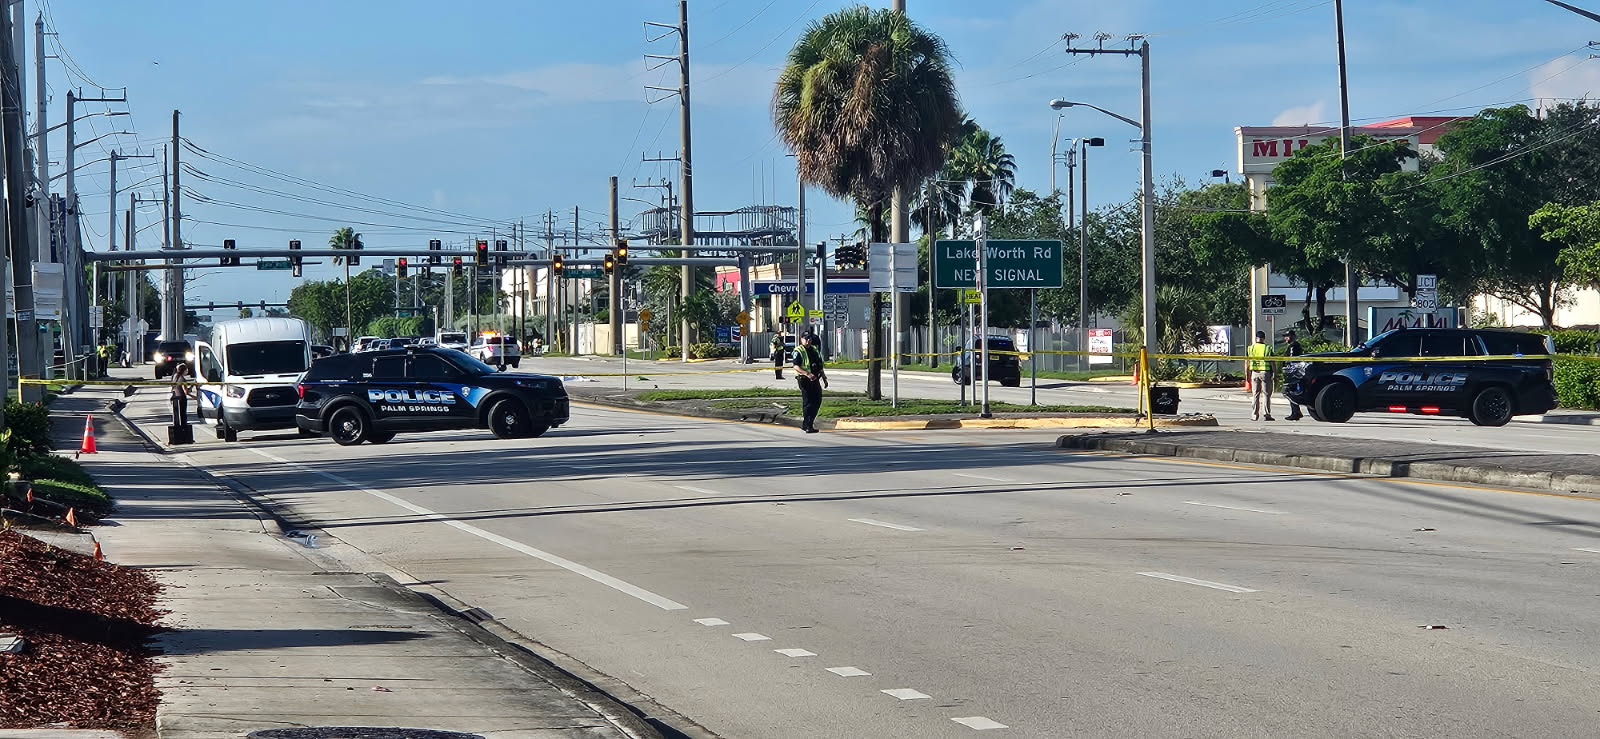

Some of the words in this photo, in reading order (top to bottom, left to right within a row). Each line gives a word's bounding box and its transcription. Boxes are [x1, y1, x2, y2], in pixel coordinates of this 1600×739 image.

[946, 247, 977, 259] Lake
[986, 247, 1026, 259] Worth
[1033, 247, 1052, 259] Rd
[954, 269, 977, 281] NEX
[994, 269, 1044, 281] SIGNAL
[1418, 277, 1436, 287] JCT
[768, 284, 808, 293] Chevr
[1417, 300, 1434, 308] 802
[1378, 372, 1468, 385] POLICE
[368, 389, 456, 404] POLICE
